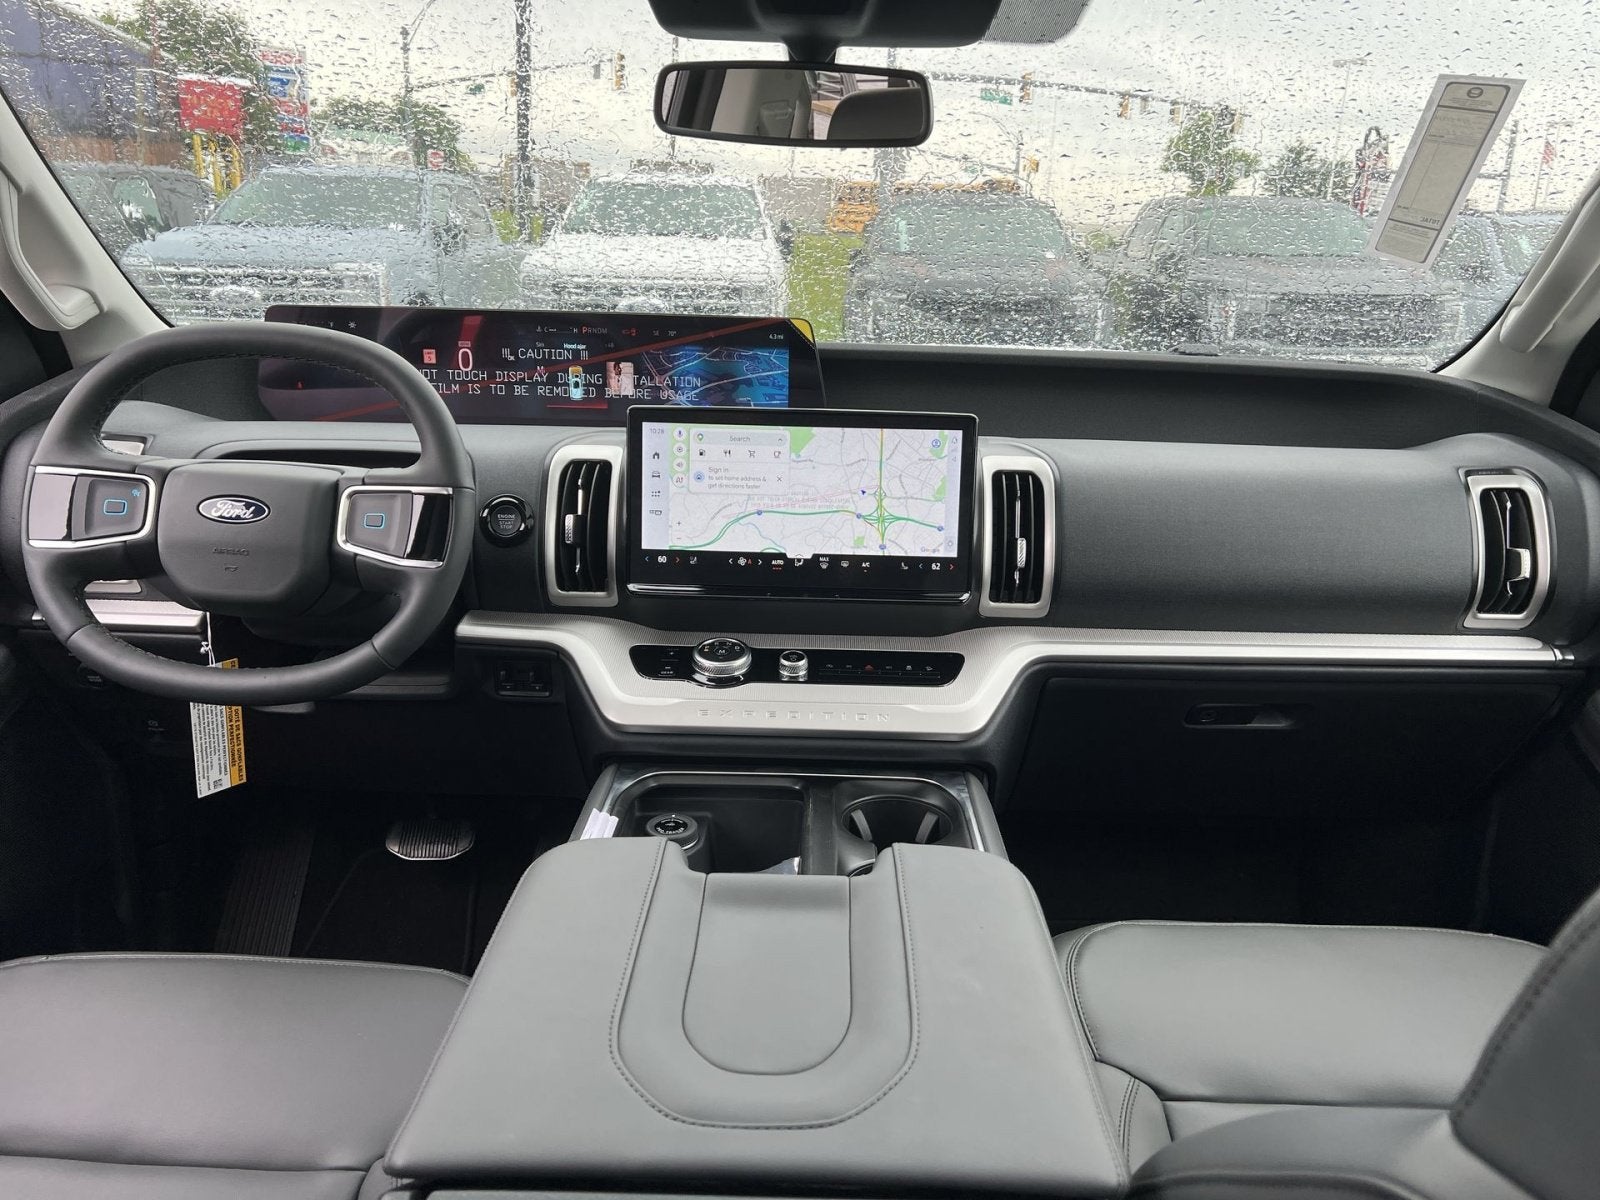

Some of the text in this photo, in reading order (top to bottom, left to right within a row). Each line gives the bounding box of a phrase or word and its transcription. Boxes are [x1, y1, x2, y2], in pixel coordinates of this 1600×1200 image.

[458, 348, 473, 371] 0
[518, 347, 572, 360] CAUTION
[446, 369, 487, 381] TOUCH
[495, 370, 549, 383] DISPLAY
[468, 383, 481, 394] IS
[489, 384, 505, 395] TO
[513, 385, 529, 396] BE
[537, 386, 597, 398] REMOED
[604, 387, 652, 400] BEORE
[659, 389, 700, 401] USAGE
[211, 500, 254, 520] Ford
[657, 555, 667, 563] 60
[931, 562, 940, 571] 62
[697, 708, 890, 722] EXPEDITION
